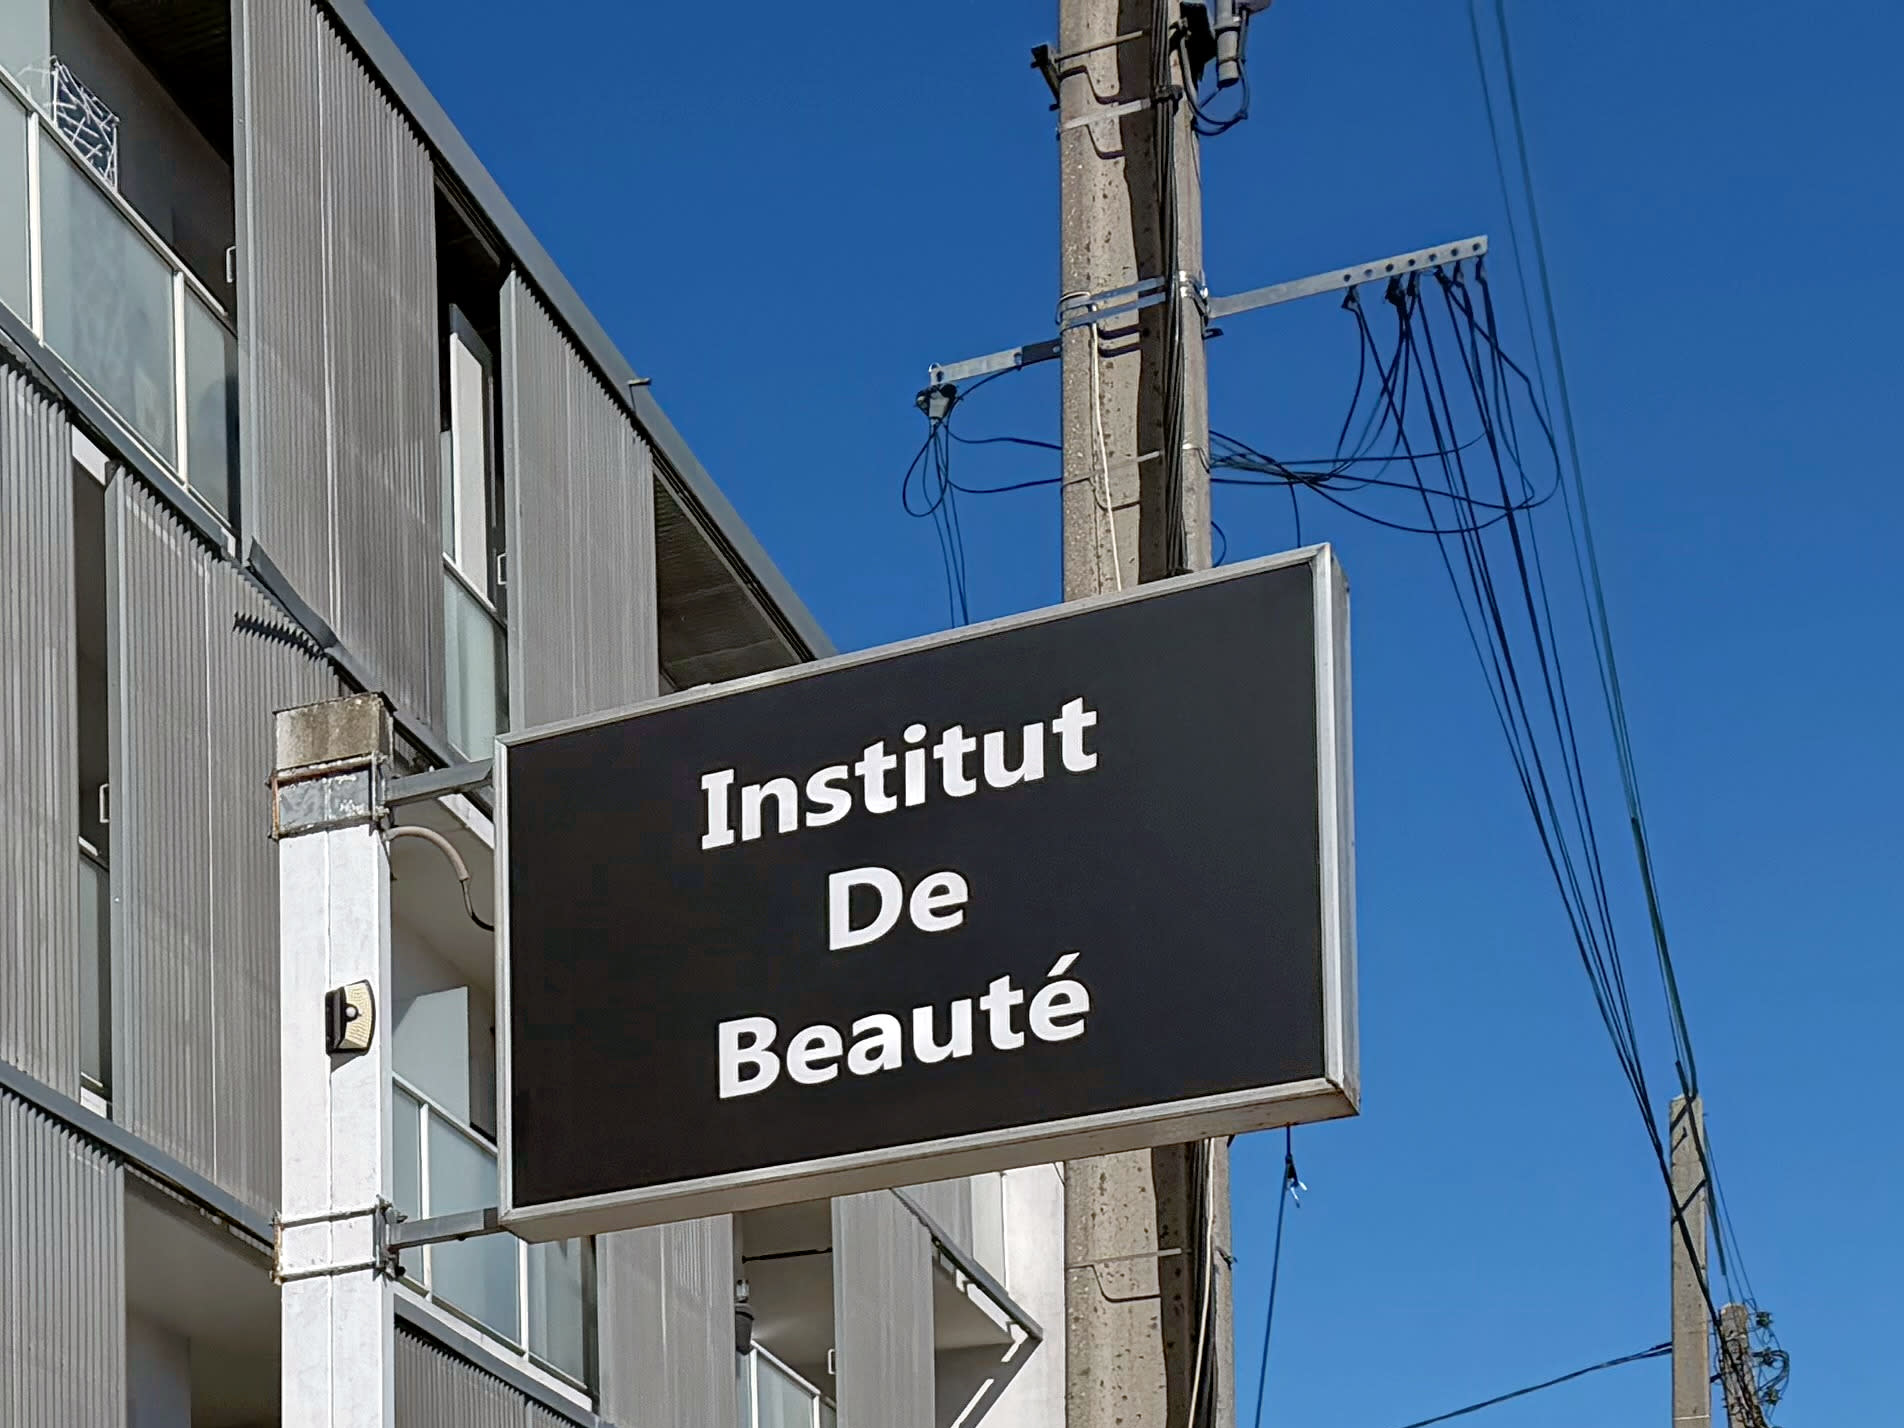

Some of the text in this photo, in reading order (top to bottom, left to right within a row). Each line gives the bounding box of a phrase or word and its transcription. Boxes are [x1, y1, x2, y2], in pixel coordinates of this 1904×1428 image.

[700, 697, 1099, 849] Institut
[828, 866, 970, 951] De
[718, 952, 1090, 1099] Beauté
